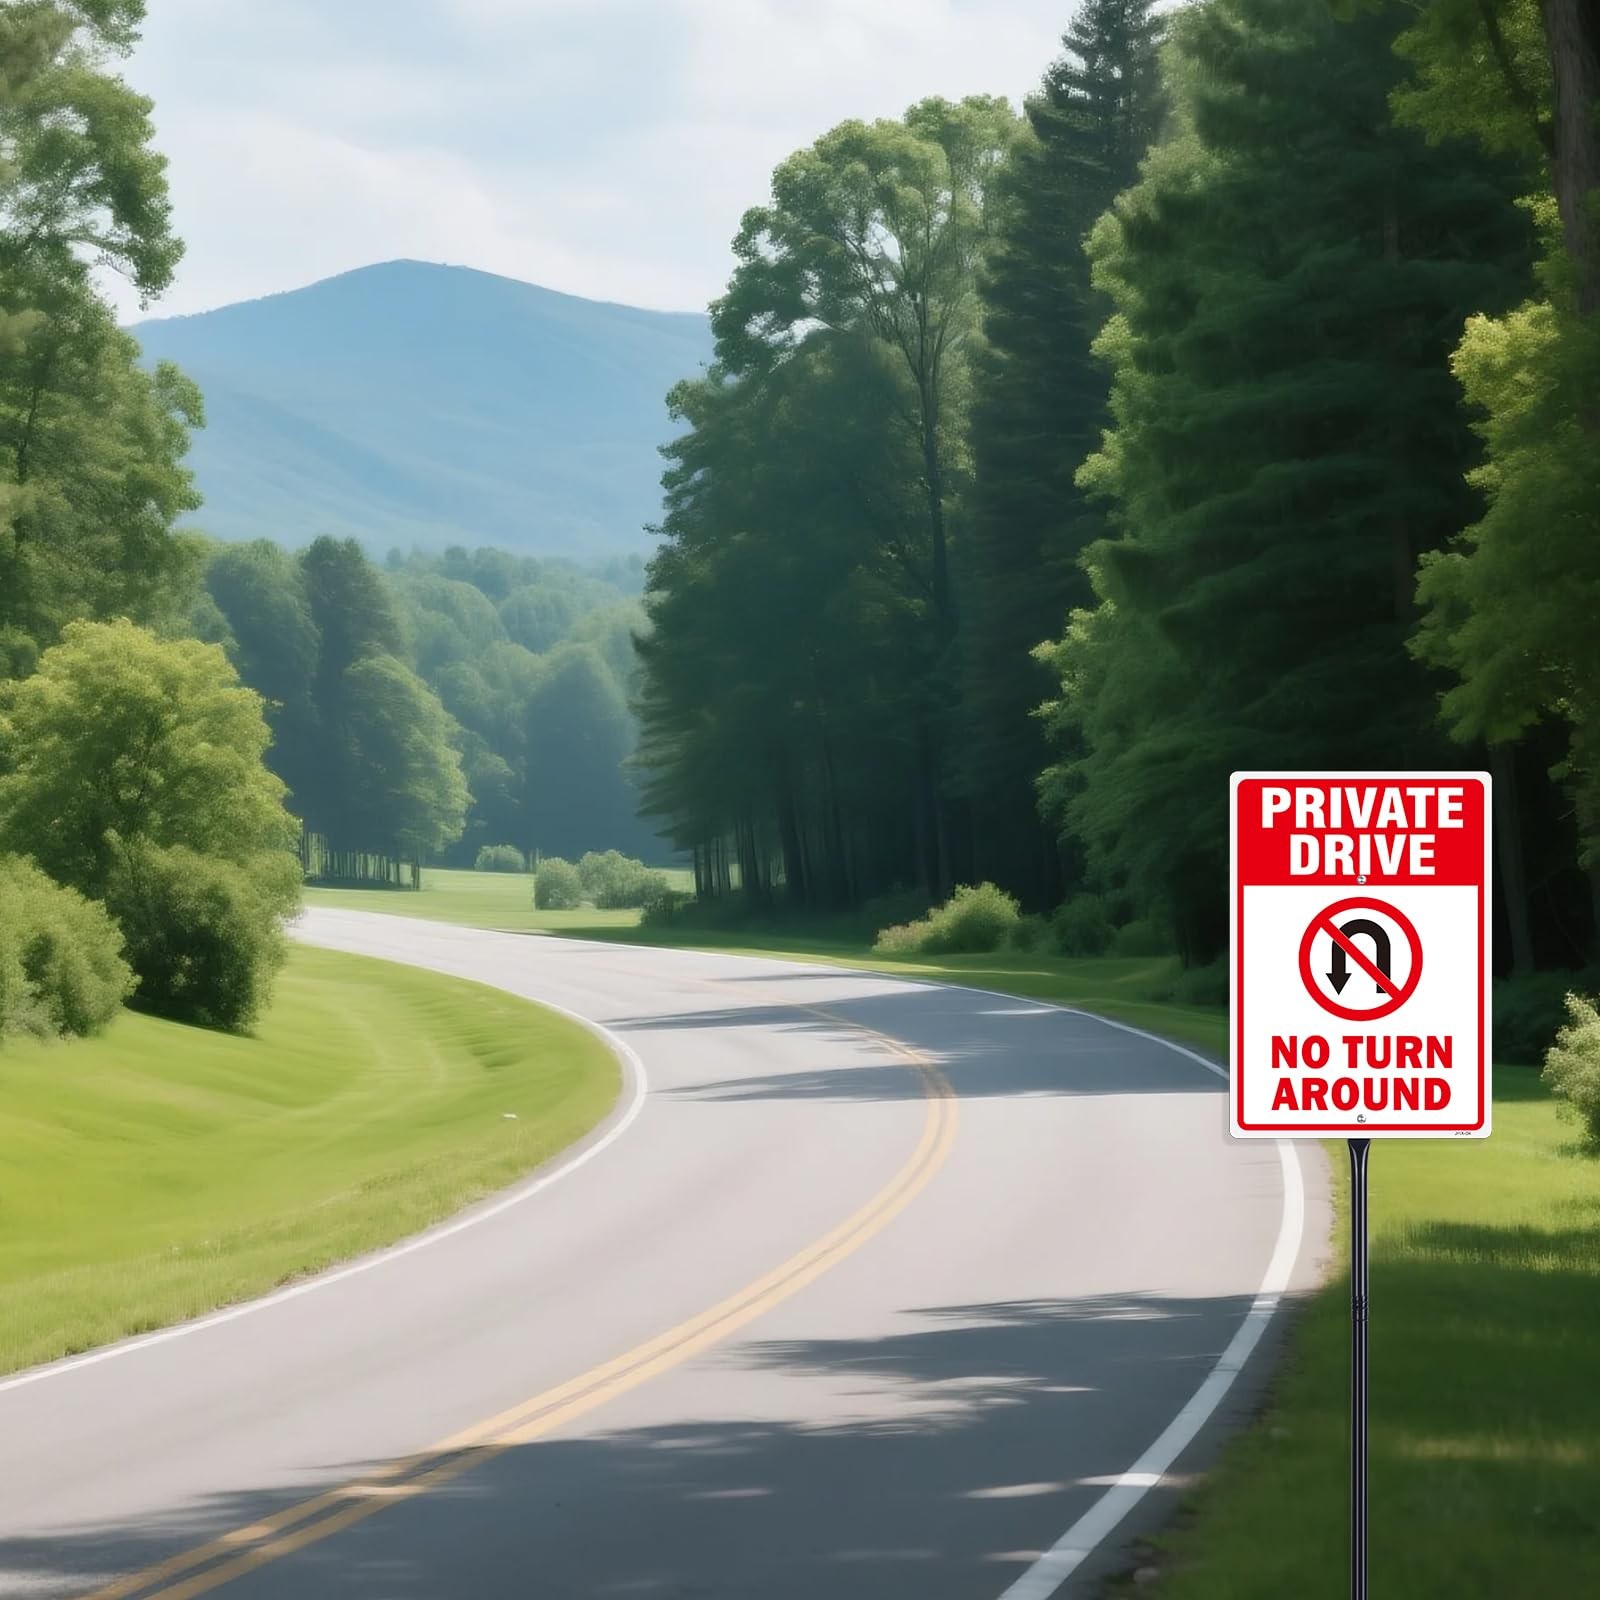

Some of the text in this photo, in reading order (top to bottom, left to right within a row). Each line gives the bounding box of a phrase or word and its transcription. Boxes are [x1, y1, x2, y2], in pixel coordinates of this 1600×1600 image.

[1261, 787, 1464, 829] PRIVATE
[1289, 834, 1436, 876] DRIVE
[1271, 1035, 1453, 1069] NO TURN
[1271, 1077, 1452, 1111] AROUND
